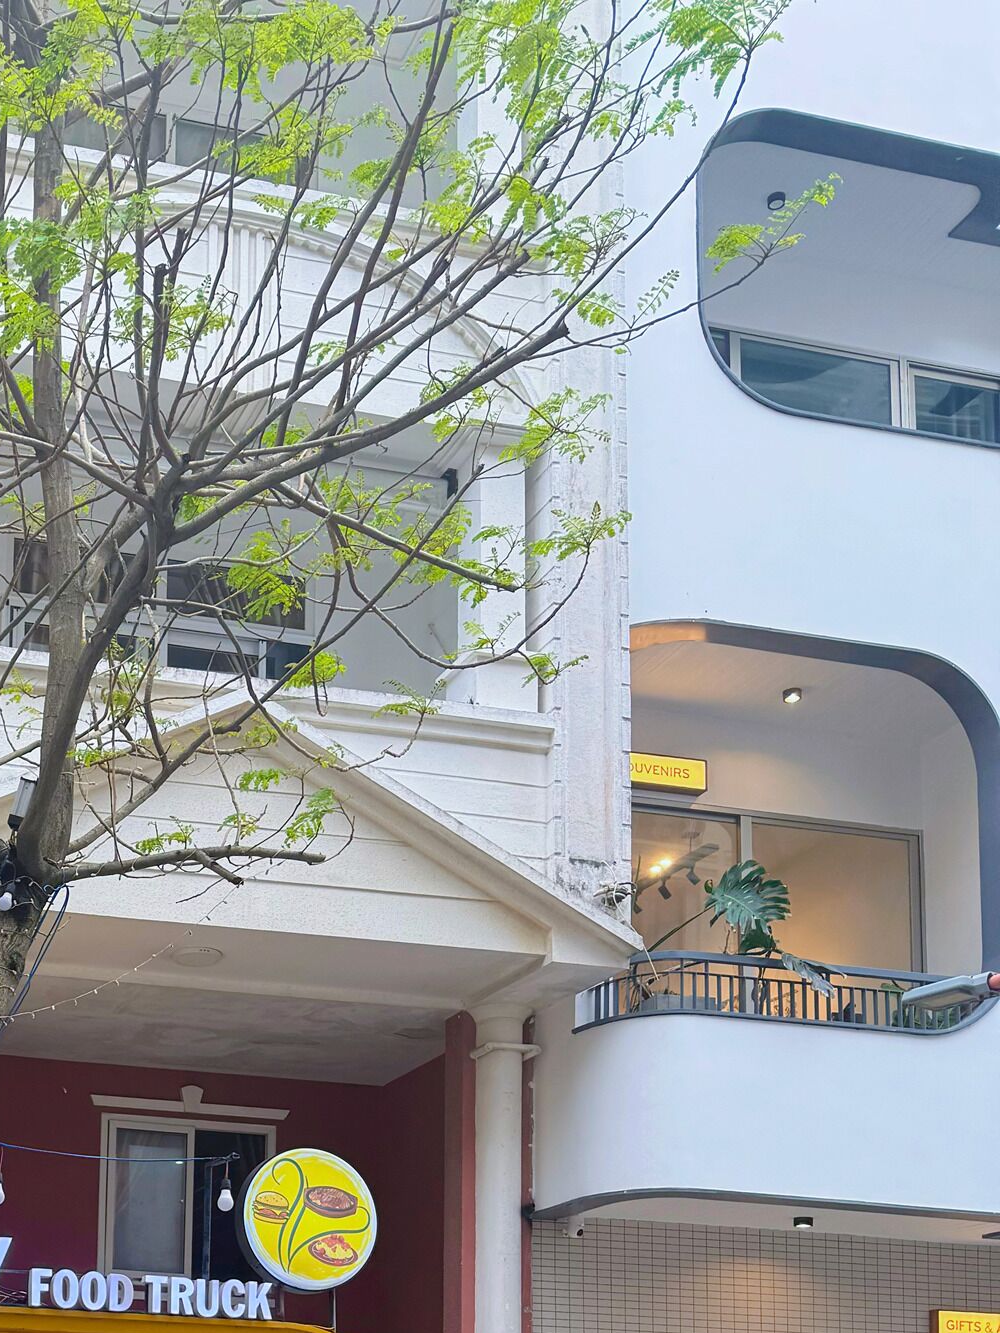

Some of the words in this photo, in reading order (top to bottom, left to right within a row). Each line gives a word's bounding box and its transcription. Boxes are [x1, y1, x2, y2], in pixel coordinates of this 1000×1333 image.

[630, 762, 690, 779] OUVENIRS
[28, 1268, 134, 1312] FOOD
[142, 1275, 273, 1321] TRUCK
[946, 1319, 982, 1333] GIFTS
[984, 1322, 993, 1333] &
